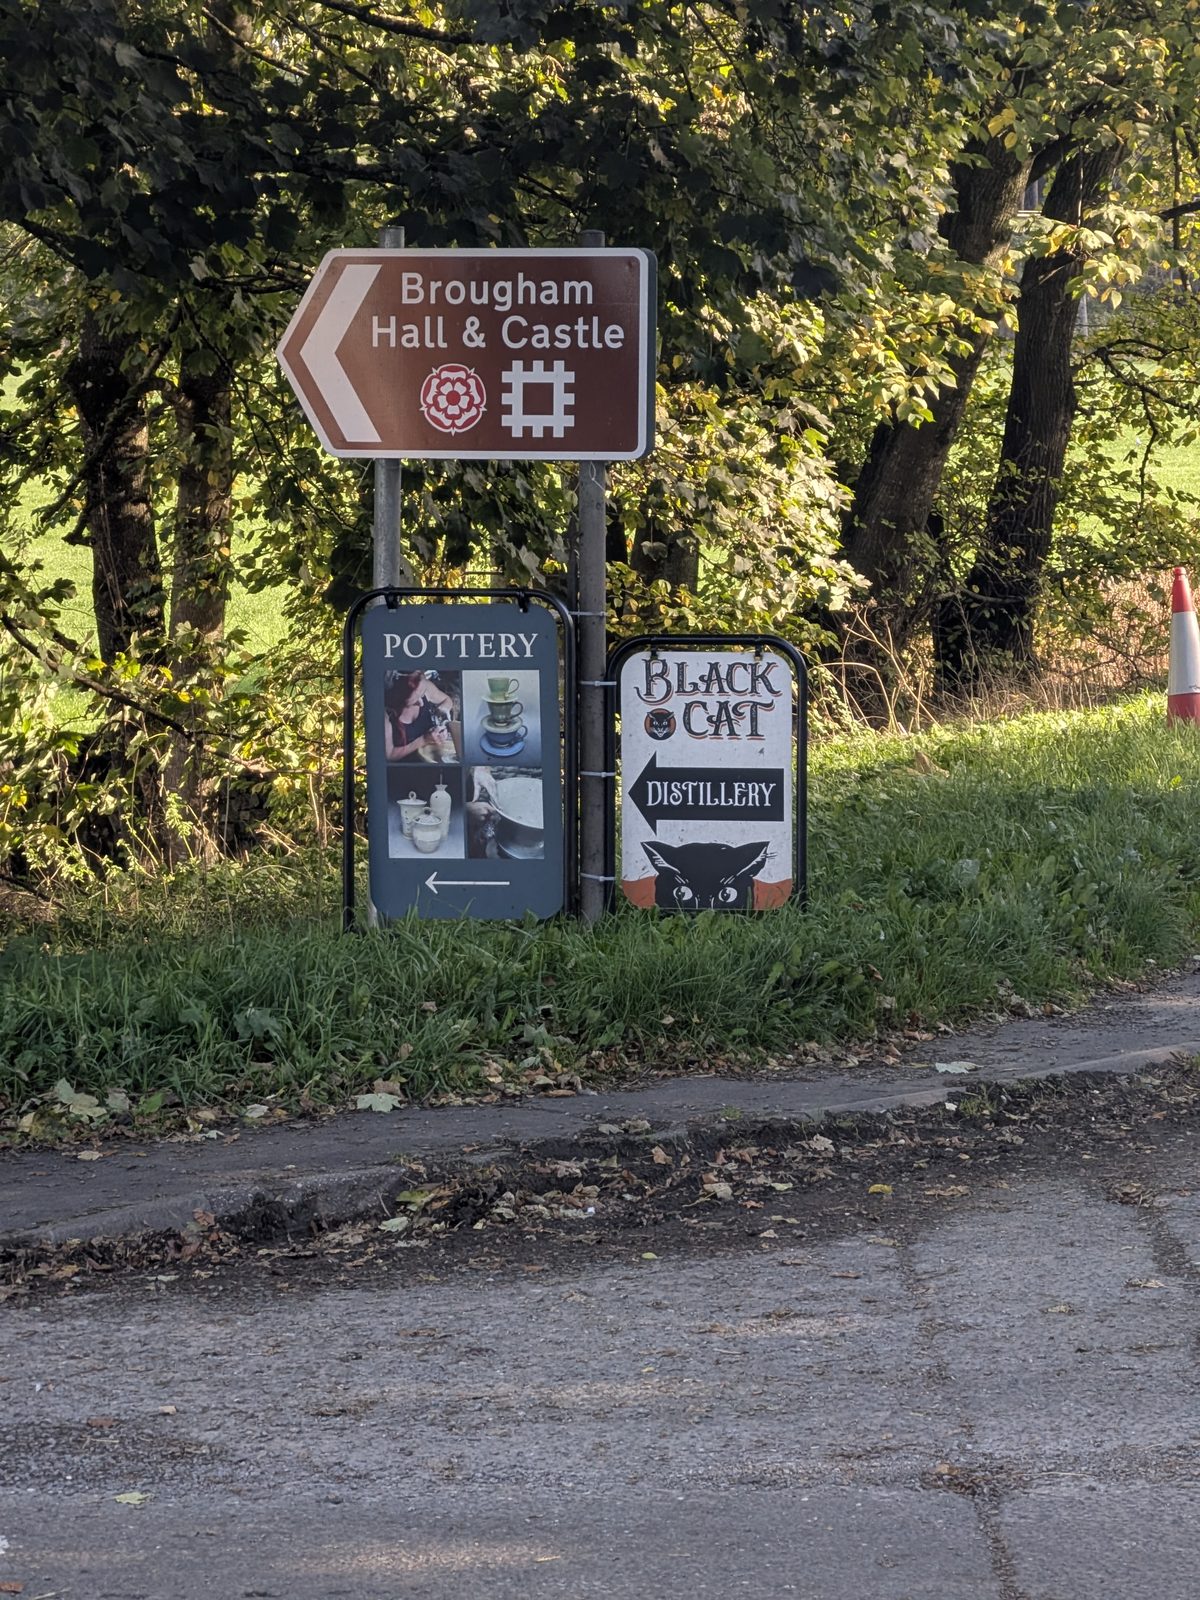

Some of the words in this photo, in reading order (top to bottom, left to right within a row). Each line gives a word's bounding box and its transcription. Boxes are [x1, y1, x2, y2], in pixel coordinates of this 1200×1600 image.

[401, 272, 593, 311] Brougham
[372, 315, 448, 348] Hall
[462, 315, 486, 348] &
[502, 315, 625, 348] Castle
[383, 633, 538, 658] POTTERY
[634, 658, 783, 705] BLACK
[683, 700, 776, 740] CAT
[646, 780, 776, 807] DISTILLERY
